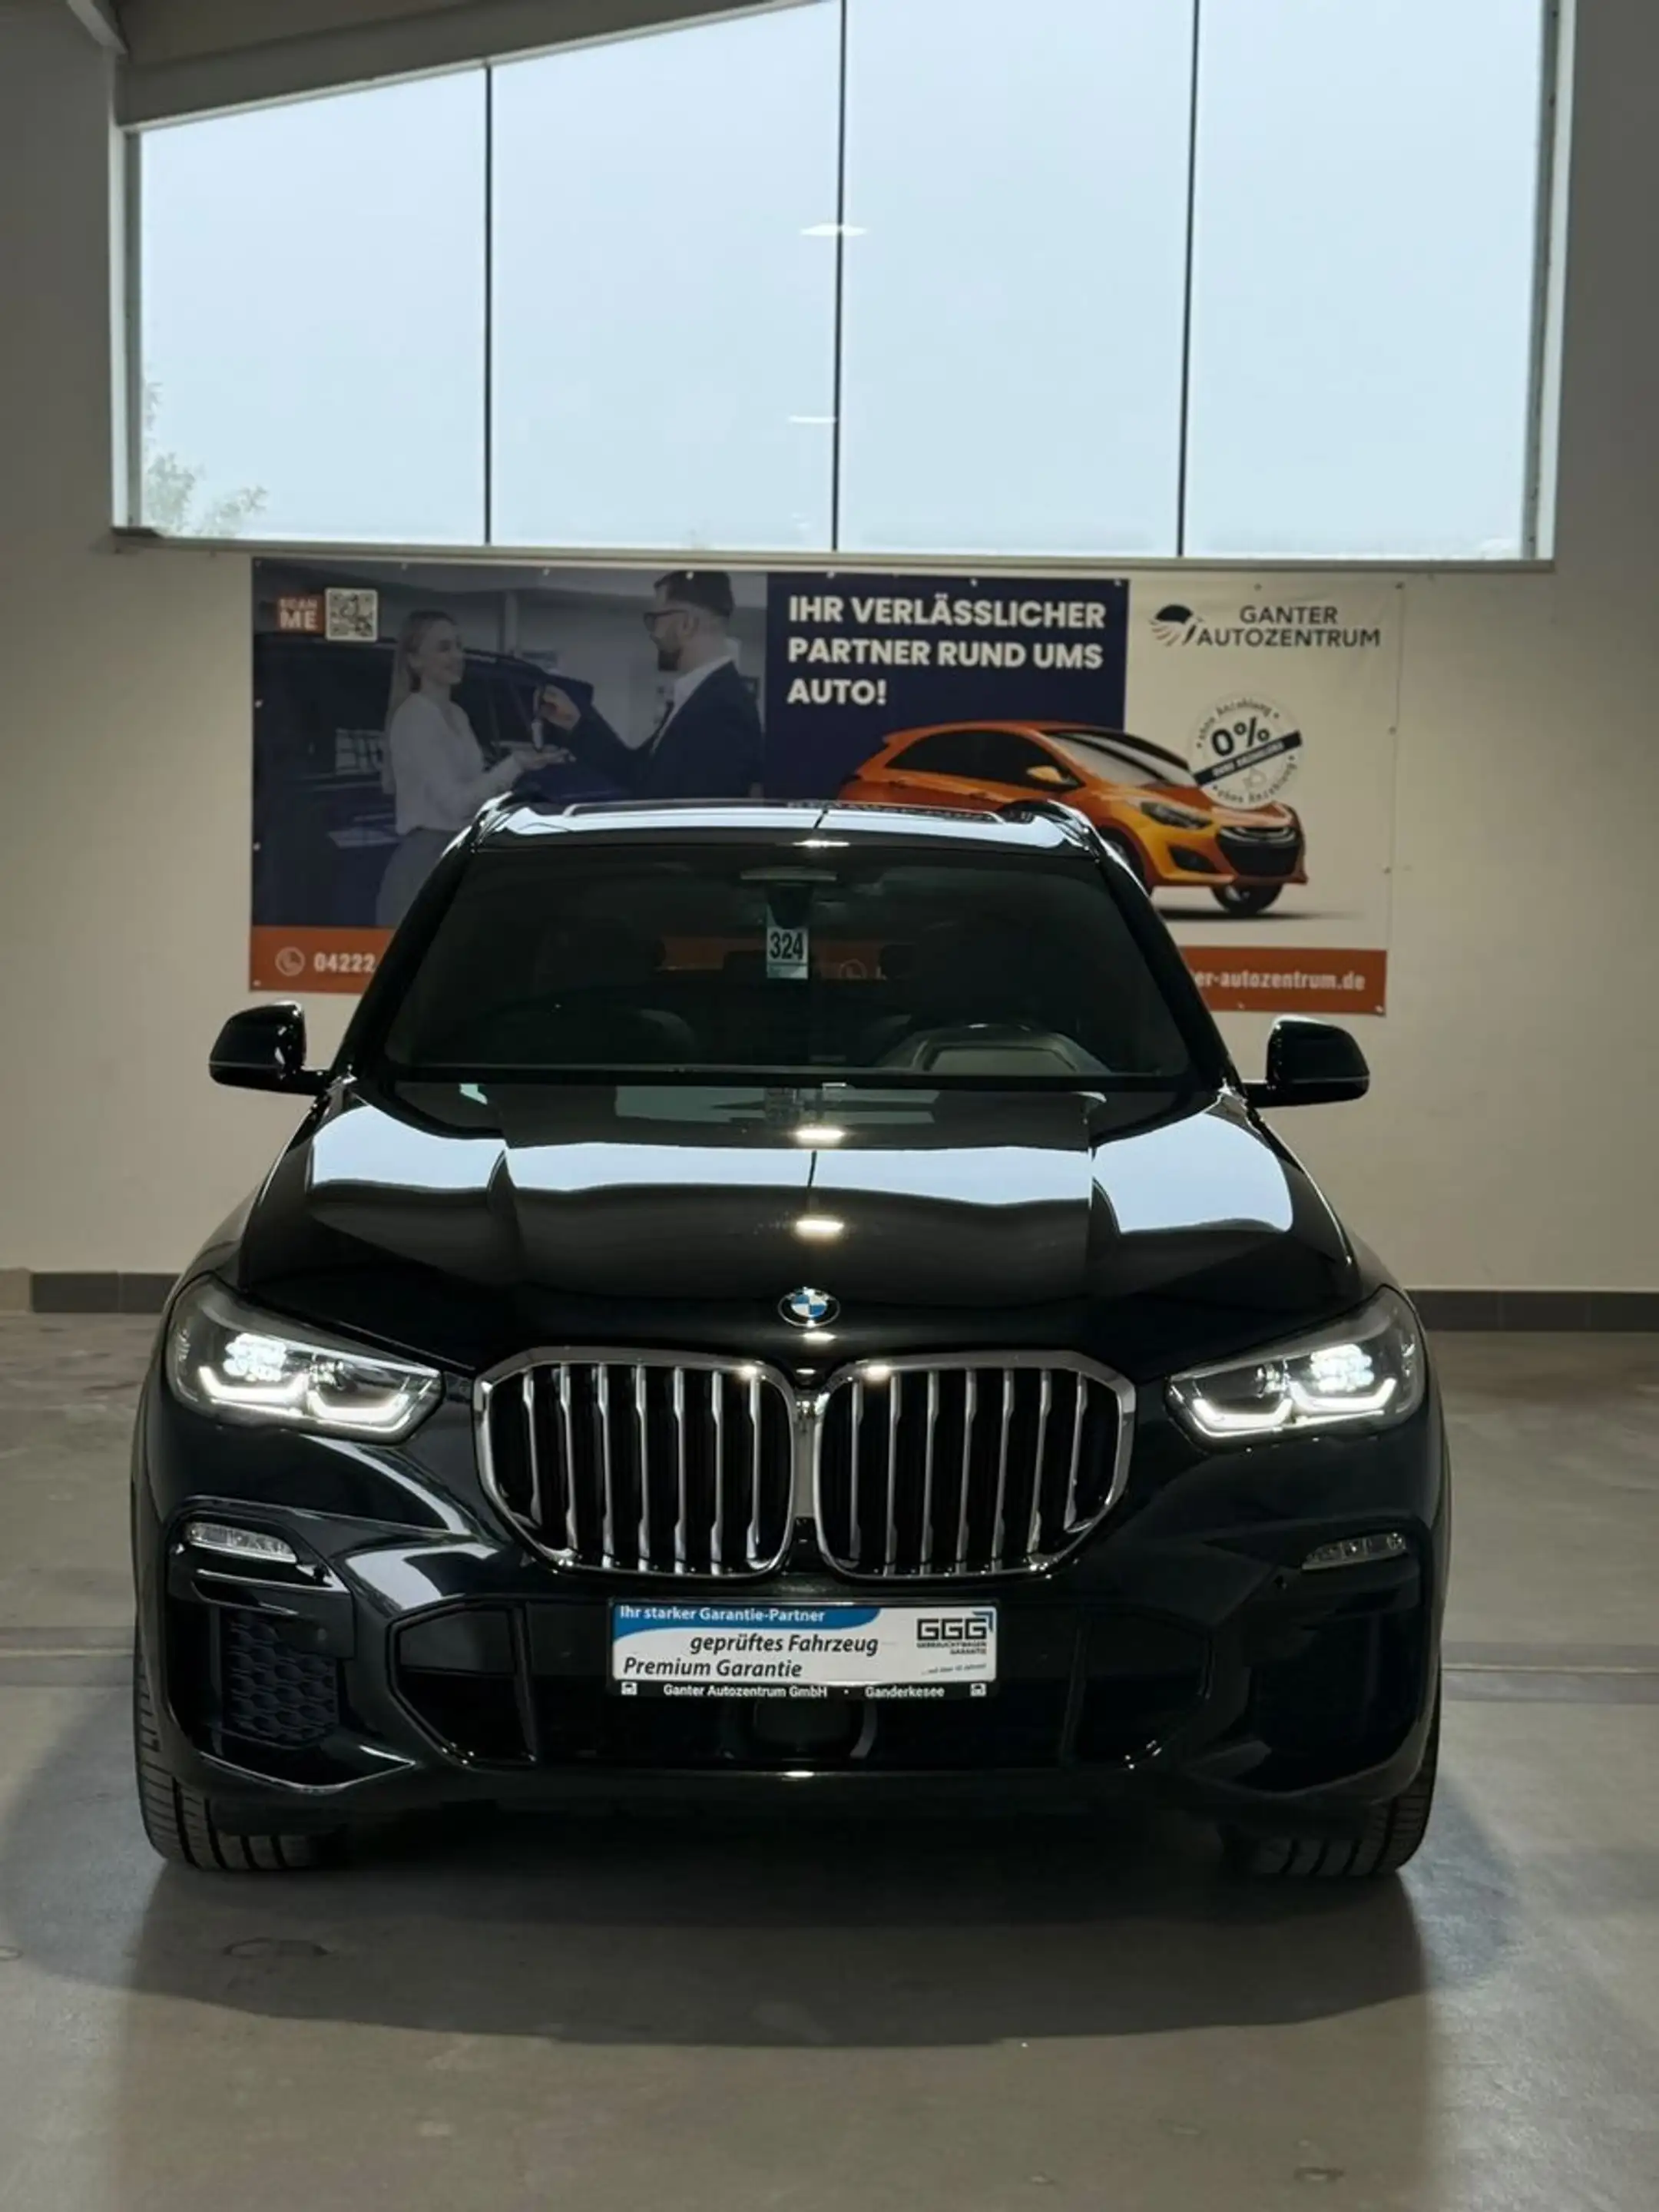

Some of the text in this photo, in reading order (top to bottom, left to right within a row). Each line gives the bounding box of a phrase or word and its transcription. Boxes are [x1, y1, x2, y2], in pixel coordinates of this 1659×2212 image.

[280, 610, 318, 630] ME
[789, 592, 1107, 629] IHR VERLÄSSLICHER
[1239, 604, 1338, 625] GANTER
[1196, 627, 1381, 647] AUTOZENTRUM
[788, 637, 1104, 670] PARTNER RUND UMS
[786, 677, 887, 706] AUTO!
[1210, 715, 1270, 757] 0%
[769, 931, 803, 961] 324
[313, 952, 376, 973] 04222
[620, 1604, 826, 1623] Ihr starker Garantie-Partner
[916, 1618, 987, 1641] GGG
[690, 1633, 879, 1657] geprüftes Fahrzeug
[622, 1657, 803, 1677] Premium Garantie
[663, 1684, 828, 1698] Ganter Autozentrum GmbH
[864, 1684, 945, 1698] Ganderkesee
